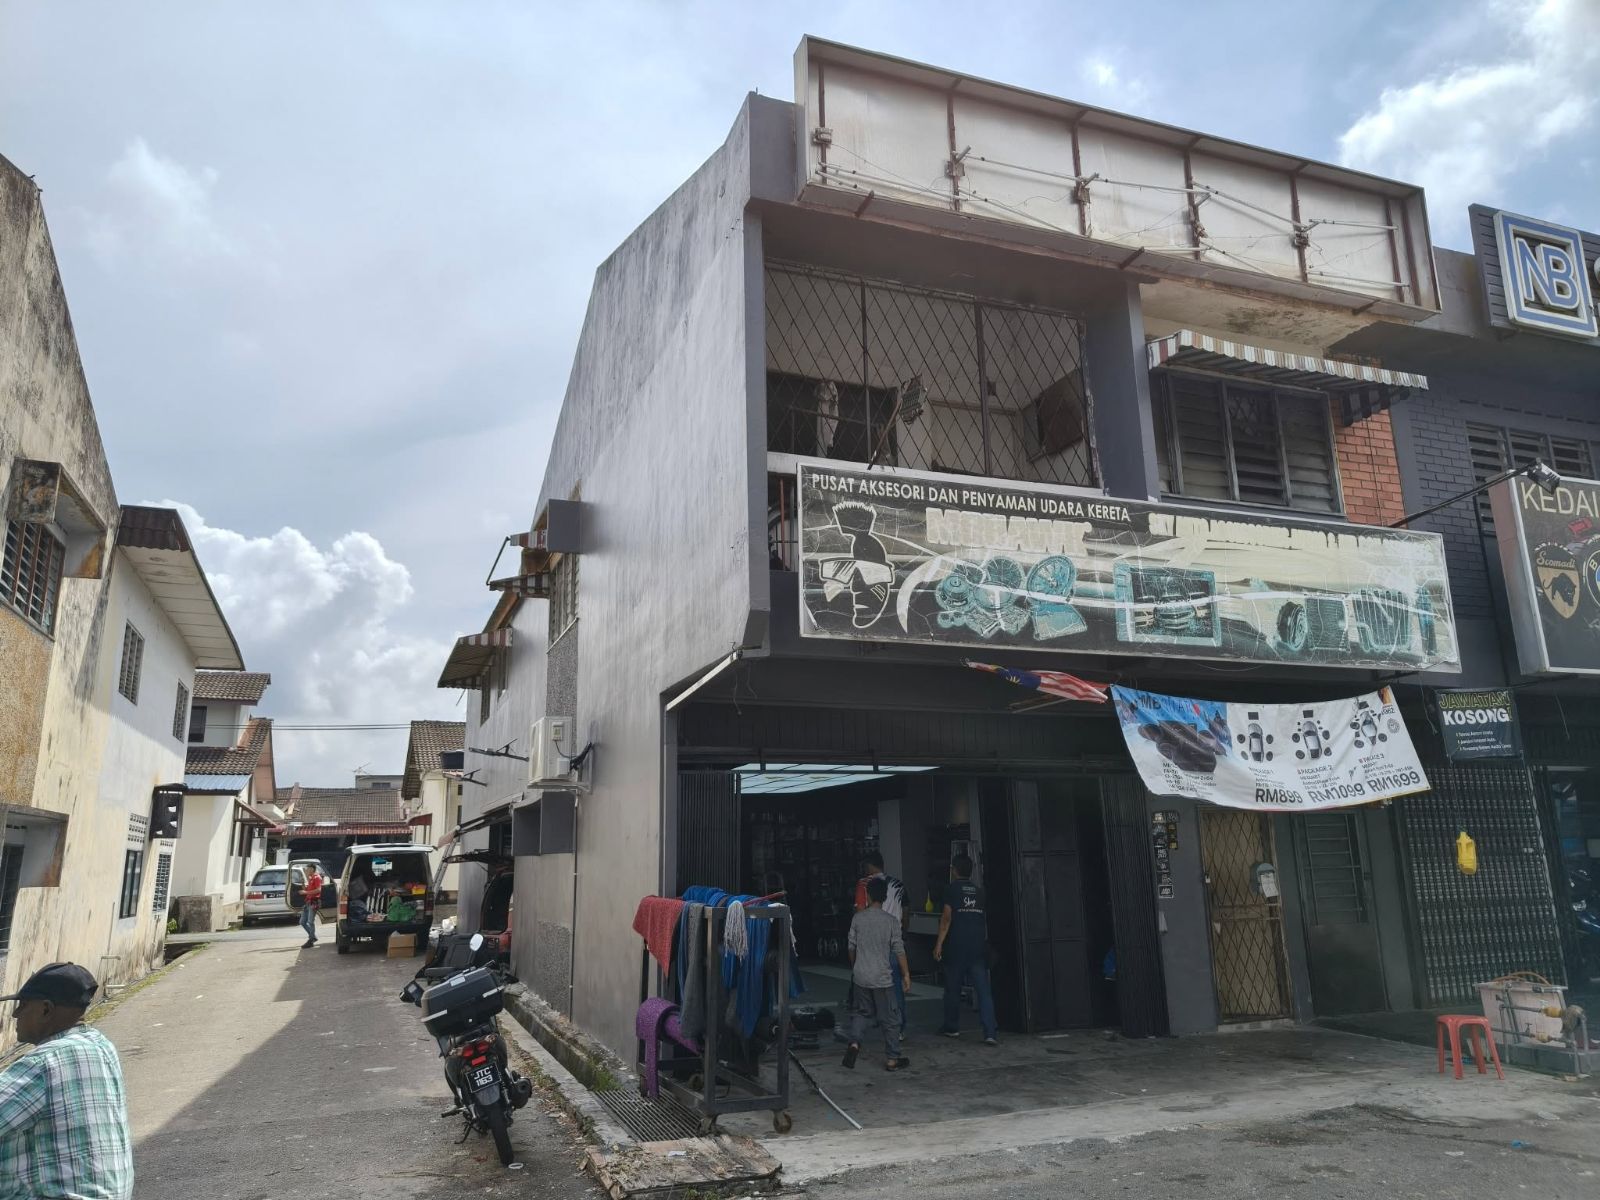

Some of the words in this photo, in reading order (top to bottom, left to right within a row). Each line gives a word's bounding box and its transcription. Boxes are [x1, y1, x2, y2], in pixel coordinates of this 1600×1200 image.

[1515, 237, 1580, 310] NB
[811, 473, 854, 493] PUSAT
[858, 479, 925, 500] AKSESORI
[928, 487, 958, 504] DAN
[962, 491, 1036, 512] PENYAMAN
[1040, 499, 1084, 518] UDARA
[1087, 504, 1131, 522] KERETA
[1520, 481, 1600, 518] KEDAI
[1536, 551, 1576, 568] Scomadi
[1439, 690, 1511, 709] JAWATAN
[1367, 770, 1421, 793] RM1699
[1255, 787, 1303, 803] RM899
[1308, 782, 1366, 803] RM1099
[474, 1067, 491, 1080] JTC
